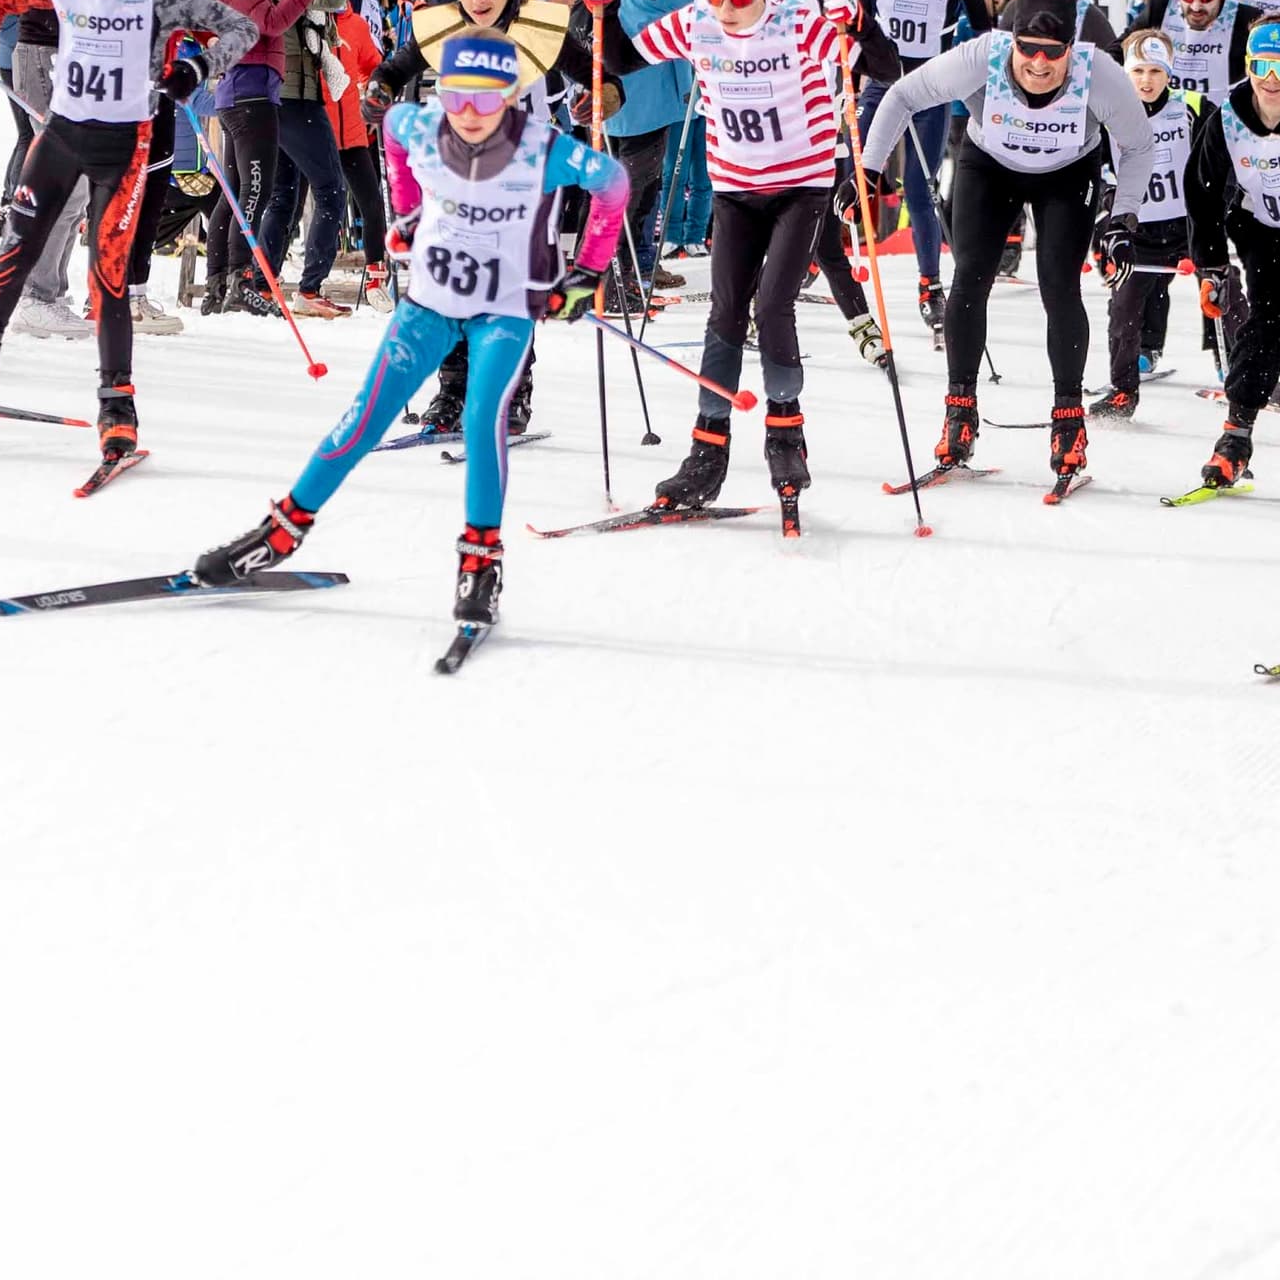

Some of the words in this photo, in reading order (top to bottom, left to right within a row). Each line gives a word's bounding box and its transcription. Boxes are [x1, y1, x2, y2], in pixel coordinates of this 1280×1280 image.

[889, 17, 928, 44] 901
[455, 50, 517, 74] SALO
[700, 53, 790, 78] ekosport
[67, 61, 124, 102] 941
[721, 106, 783, 143] 981
[991, 113, 1078, 134] ekosport
[1142, 170, 1179, 205] 61
[426, 245, 500, 303] 831
